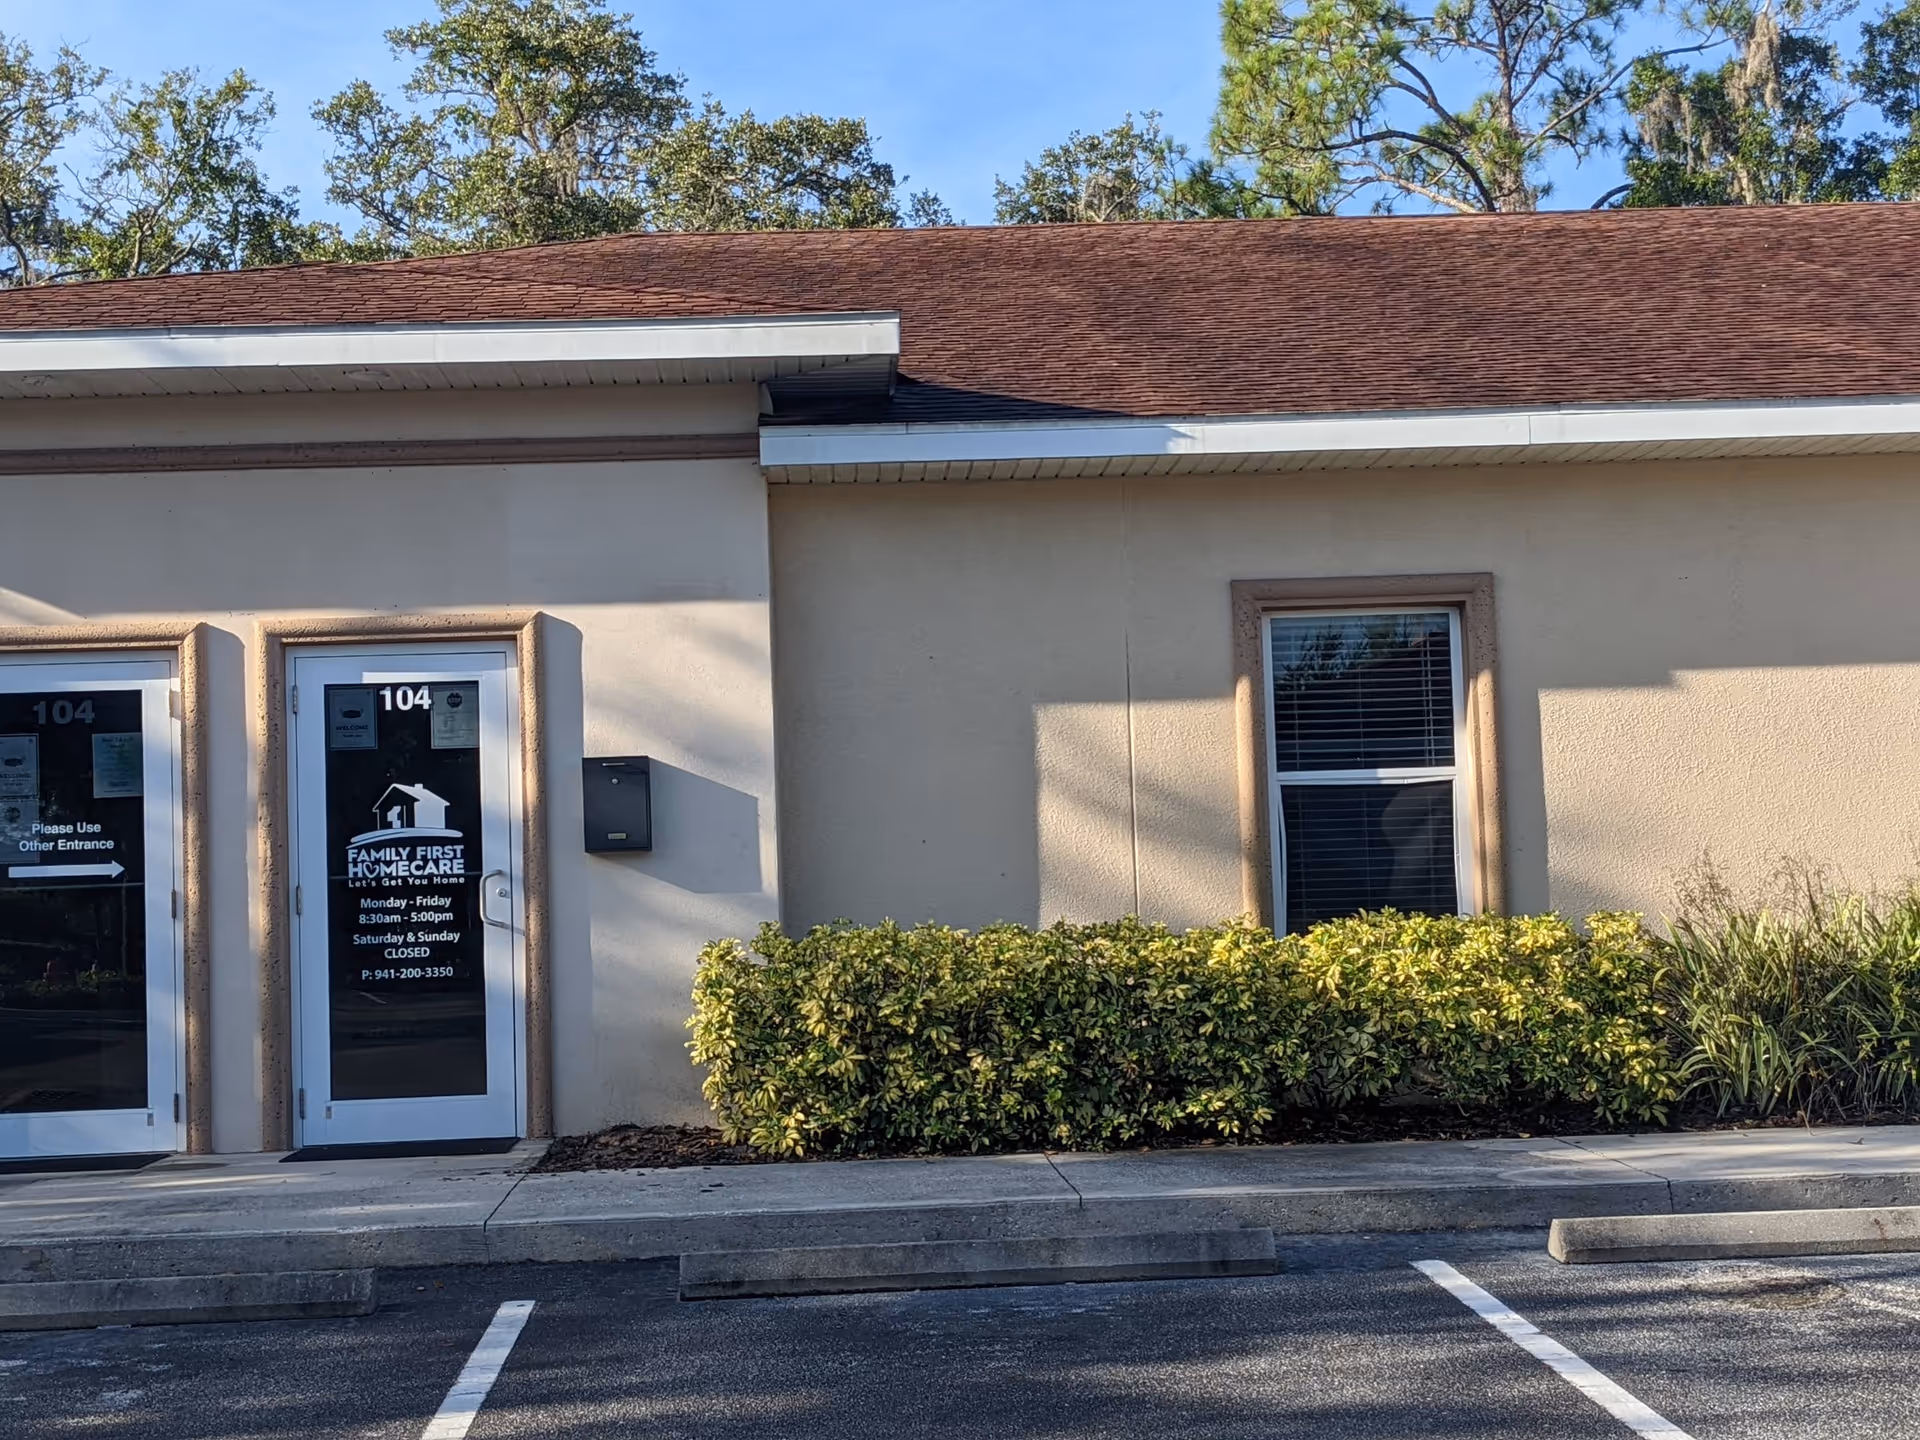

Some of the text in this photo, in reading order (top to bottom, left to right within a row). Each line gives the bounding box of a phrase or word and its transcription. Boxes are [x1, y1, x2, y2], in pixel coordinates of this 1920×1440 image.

[380, 686, 432, 711] 104
[33, 700, 95, 725] 104
[32, 822, 102, 834] Please Use
[19, 839, 115, 851] Other Entrance
[348, 845, 465, 863] FAMILY FIRST
[348, 859, 465, 878] HOMECARE
[348, 876, 466, 888] Let's Get You Home
[360, 897, 408, 910] Monday
[416, 896, 452, 908] Friday
[359, 913, 402, 924] 8:30am
[410, 911, 454, 923] 5:00pm
[353, 931, 461, 945] Saturday & Sunday
[384, 947, 430, 959] CLOSED
[361, 966, 454, 980] P: 941-200-3350
